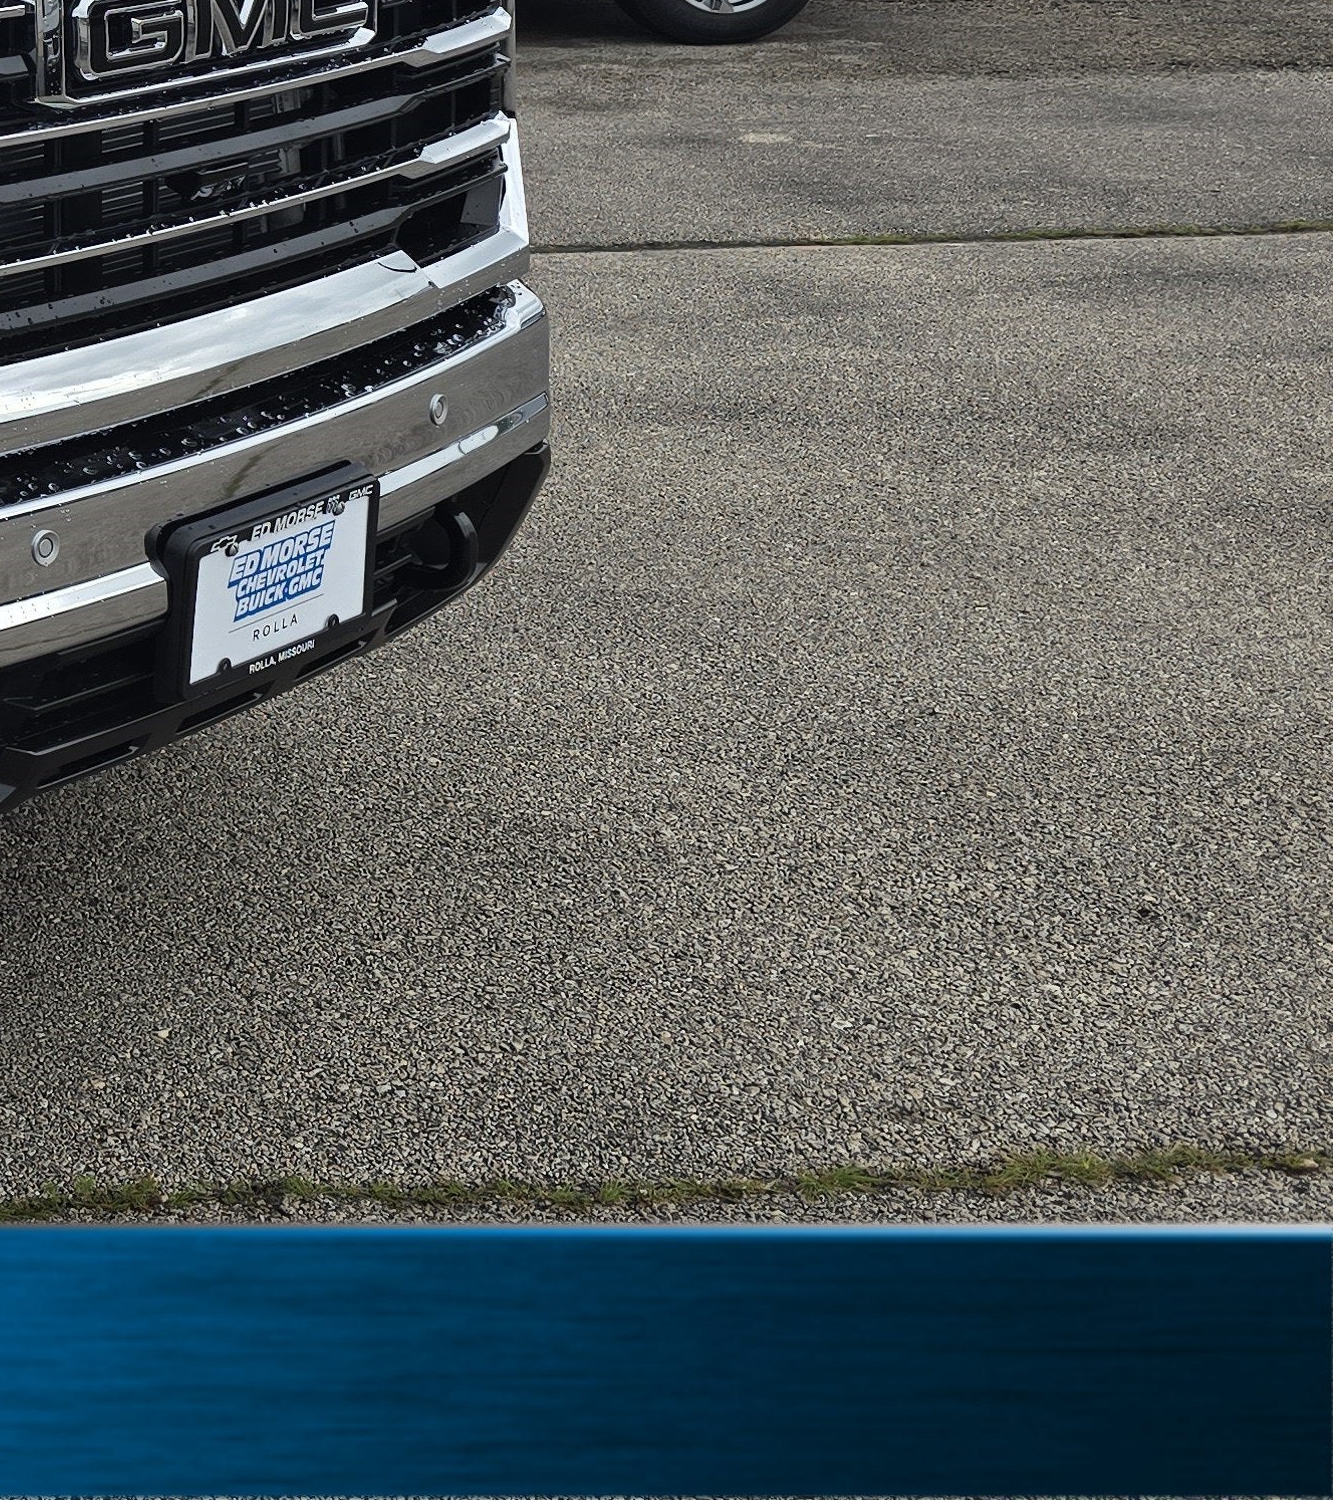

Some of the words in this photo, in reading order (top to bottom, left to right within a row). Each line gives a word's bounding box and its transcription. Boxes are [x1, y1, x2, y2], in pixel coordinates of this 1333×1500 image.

[349, 484, 374, 501] GMC
[251, 521, 272, 541] ED
[273, 500, 325, 535] MORSE
[229, 548, 262, 584] ED
[258, 521, 334, 572] MORSE
[236, 548, 324, 599] CHEVROLET
[252, 613, 298, 642] ROLLA
[277, 639, 316, 663] MISSOURI
